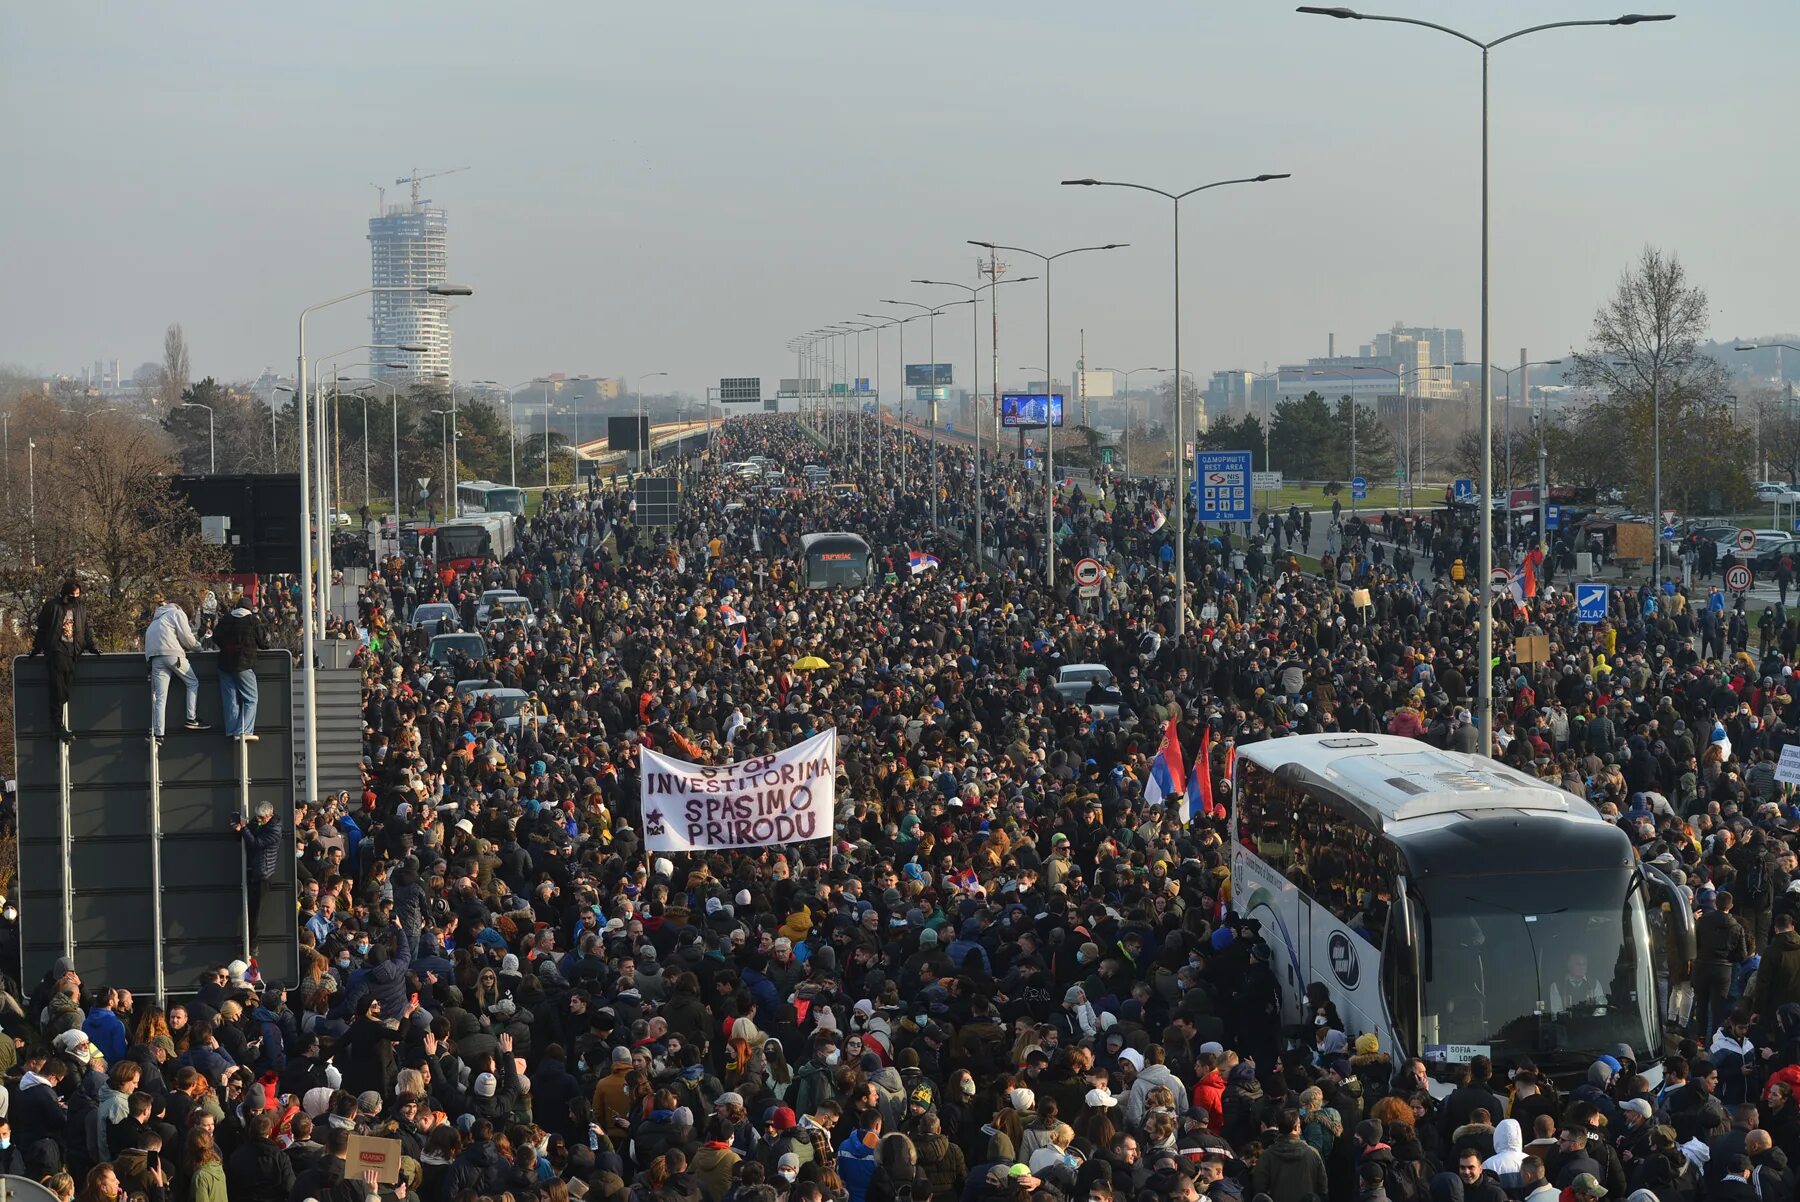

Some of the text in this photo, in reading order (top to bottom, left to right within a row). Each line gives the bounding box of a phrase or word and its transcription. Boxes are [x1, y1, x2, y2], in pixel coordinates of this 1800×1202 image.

[1731, 572, 1747, 584] 40
[1579, 610, 1605, 618] IZLAZ
[647, 757, 832, 795] INVESTITORIMA
[701, 754, 776, 779] STOP
[685, 784, 812, 823] SPASIMO
[687, 811, 816, 846] PRIRODU
